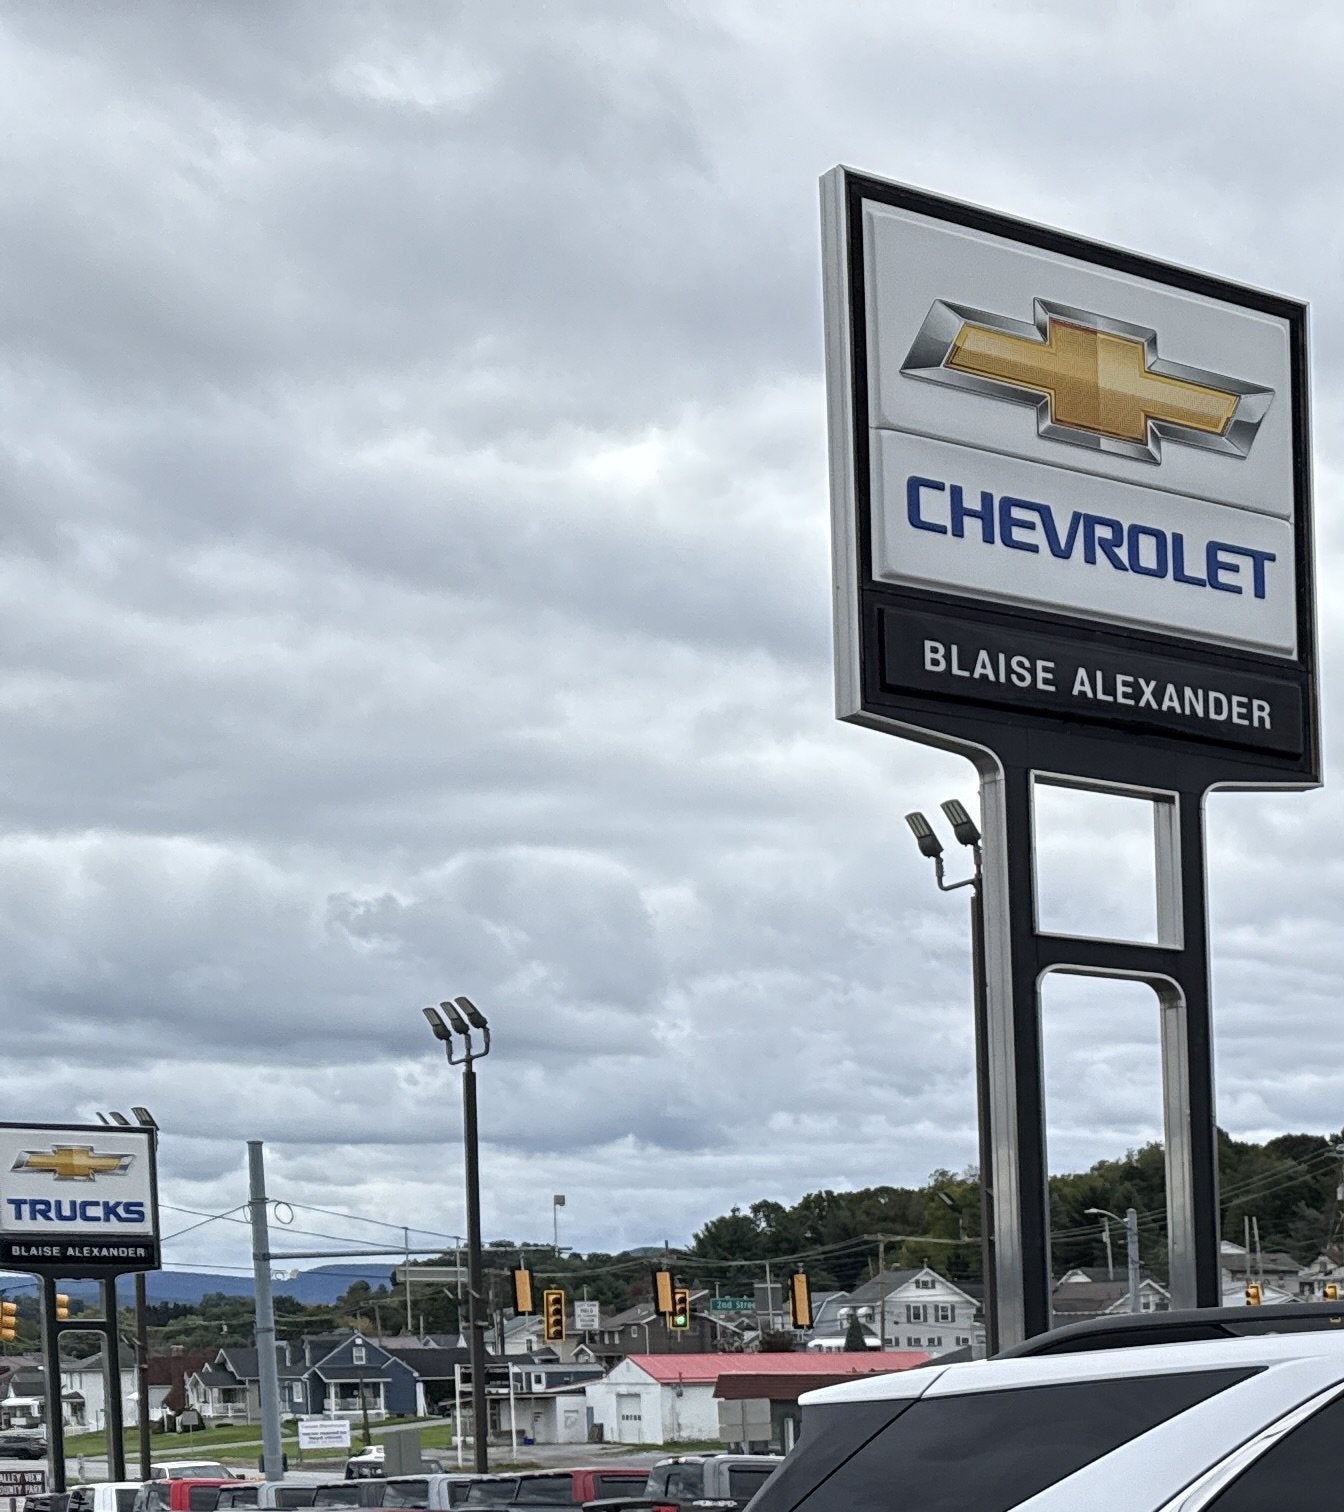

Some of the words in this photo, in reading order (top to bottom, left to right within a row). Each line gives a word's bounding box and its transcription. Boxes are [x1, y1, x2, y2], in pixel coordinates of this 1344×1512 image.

[907, 475, 1276, 599] CHEVROLET
[923, 639, 1056, 692] BLAISE
[1071, 667, 1272, 730] ALEXANDER
[7, 1198, 145, 1223] TRUCKS
[12, 1246, 61, 1257] BLAISE
[67, 1247, 146, 1258] ALEXANDER
